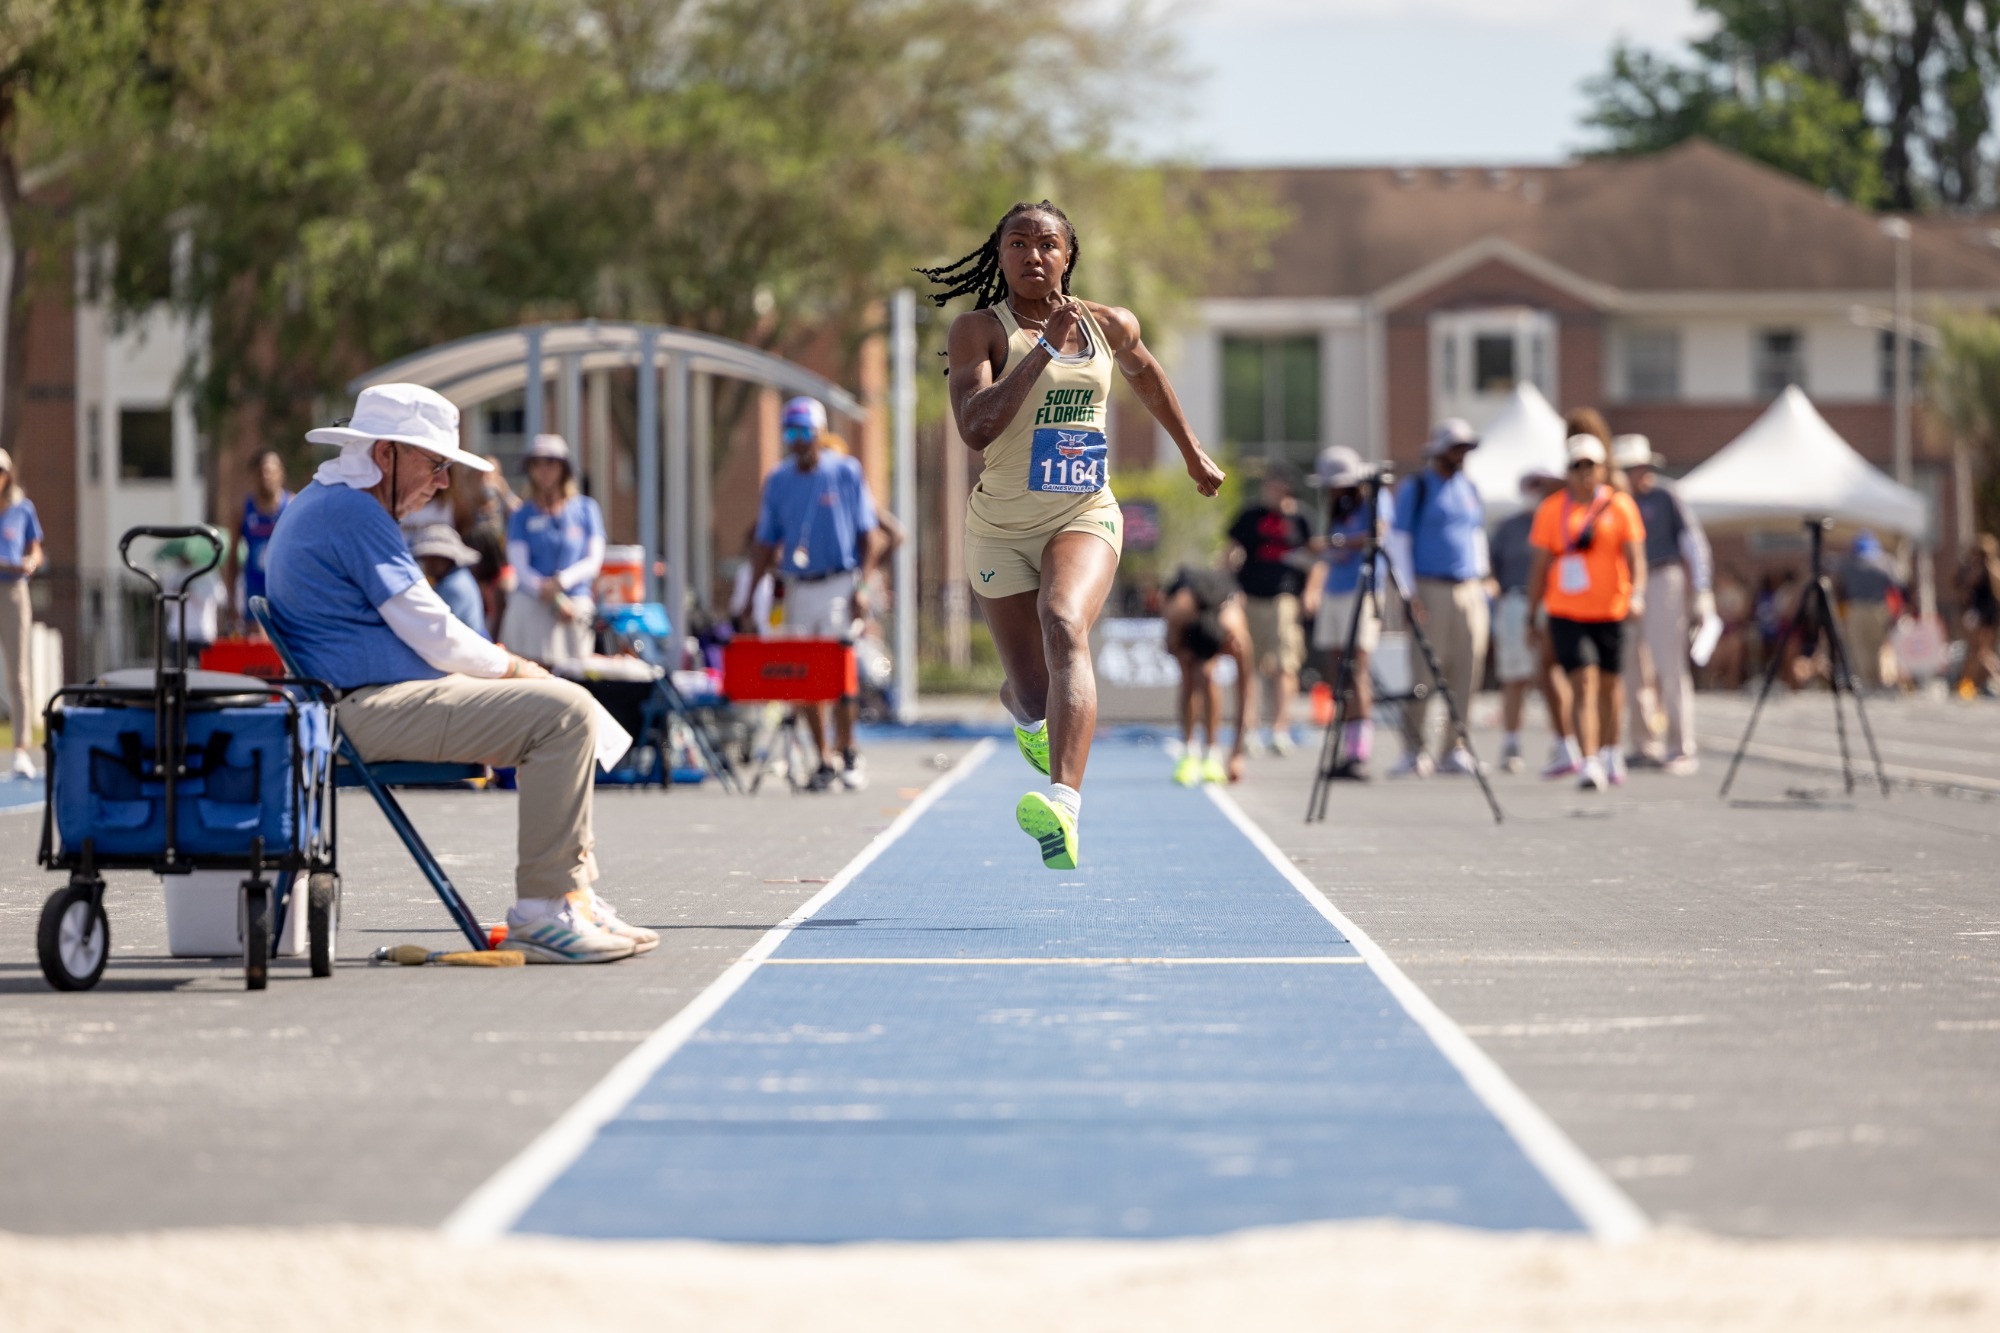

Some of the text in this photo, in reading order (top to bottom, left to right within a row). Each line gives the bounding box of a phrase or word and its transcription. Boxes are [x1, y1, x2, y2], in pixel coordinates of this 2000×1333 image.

[1044, 389, 1094, 406] SOUTH
[1034, 406, 1095, 425] FLORIDA
[1041, 458, 1098, 485] 1164
